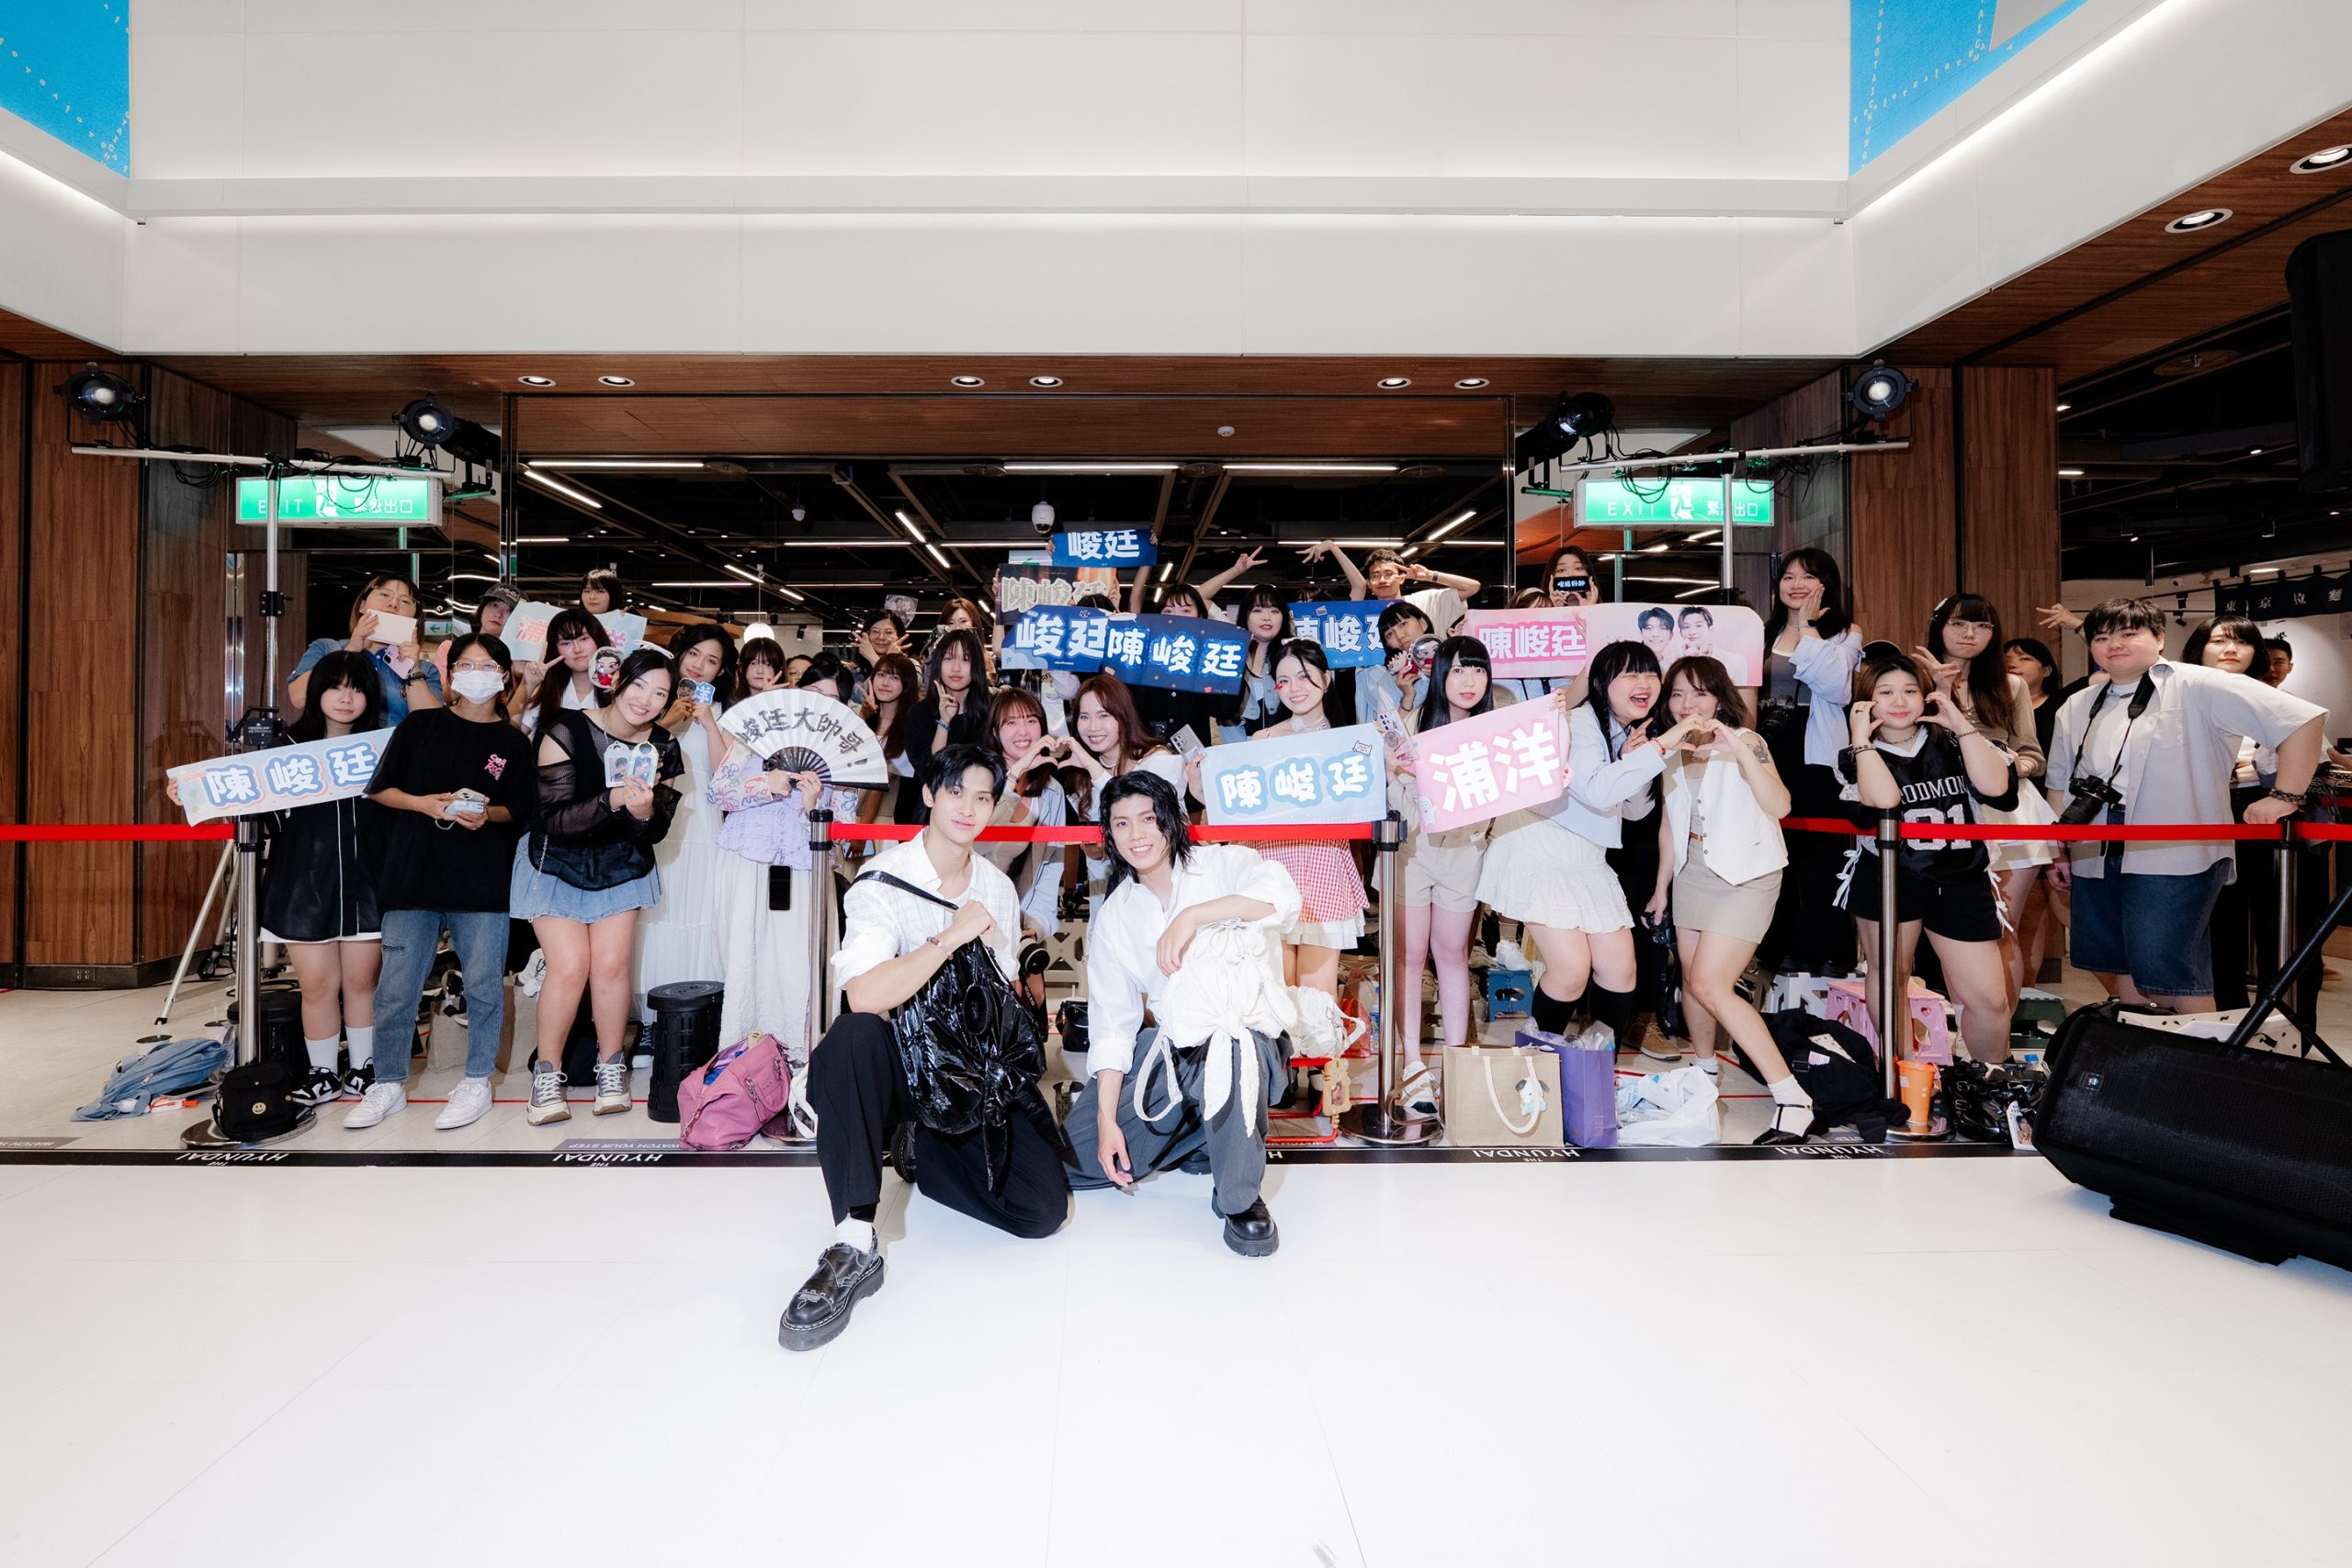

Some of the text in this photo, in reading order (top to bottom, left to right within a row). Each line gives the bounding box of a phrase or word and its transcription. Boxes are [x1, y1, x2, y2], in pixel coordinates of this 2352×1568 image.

[258, 499, 303, 514] EIT
[1707, 501, 1758, 516] 緊出口
[1068, 529, 1140, 560] 峻廷
[1016, 614, 1109, 659] 峻廷
[1478, 625, 1587, 660] 陳峻廷
[1107, 628, 1242, 678] 陳峻廷
[205, 745, 375, 804] 陳峻廷
[1220, 754, 1368, 808] 陳峻廷
[1429, 722, 1560, 813] 浦洋
[1901, 775, 1968, 805] ODMON
[175, 1153, 289, 1161] HYUNDAI
[552, 1154, 663, 1162] HYUNDAI
[1472, 1149, 1580, 1157] HYUNDAI
[1775, 1145, 1884, 1155] HYUNDAI
